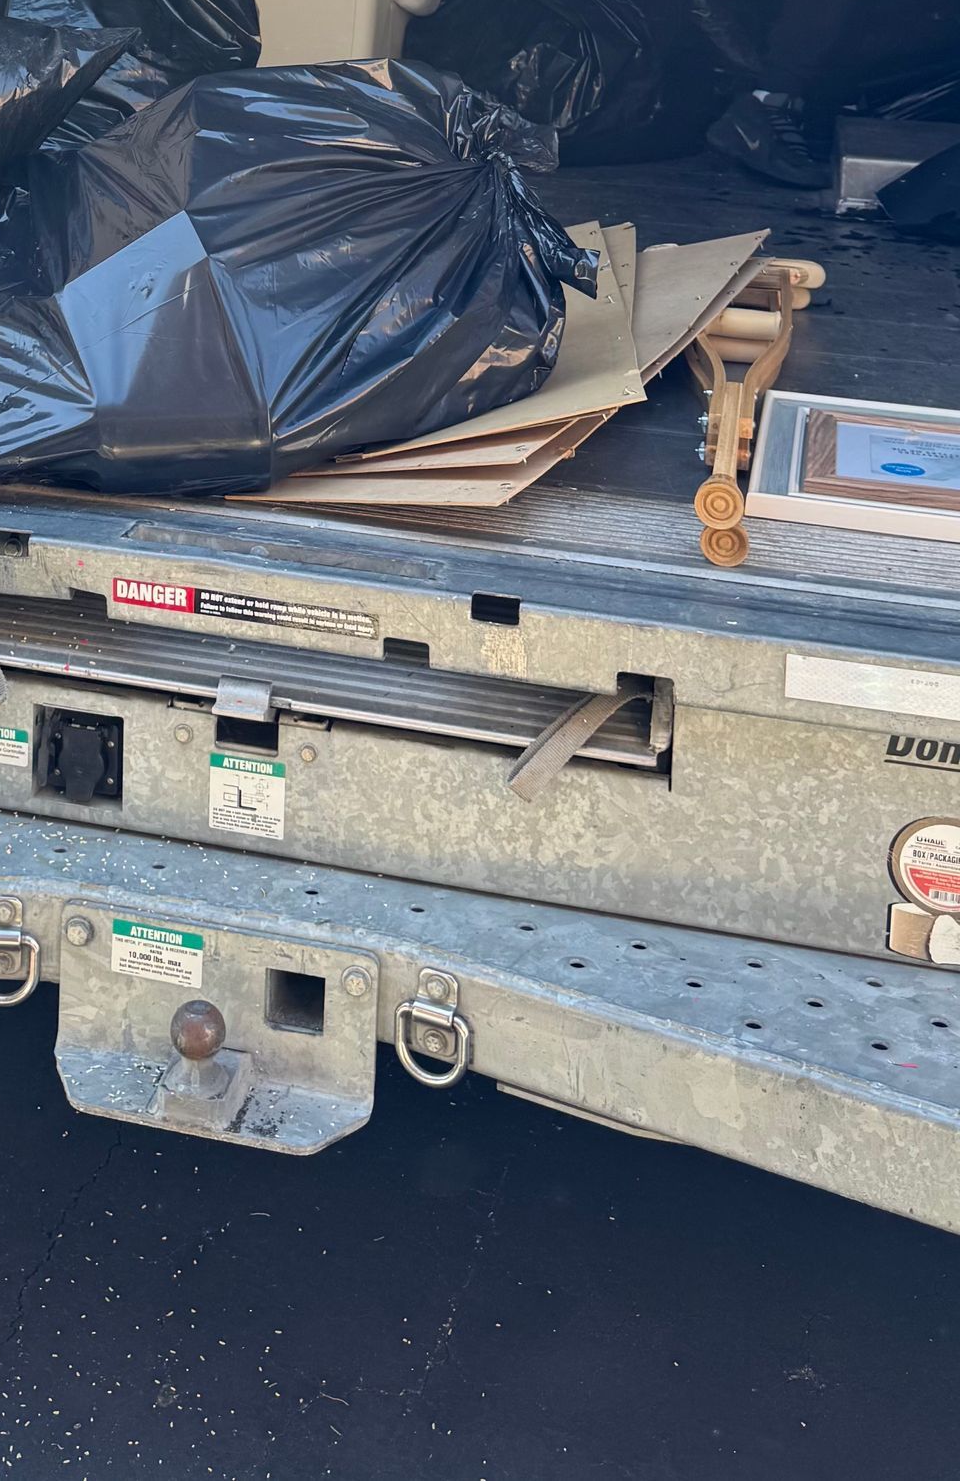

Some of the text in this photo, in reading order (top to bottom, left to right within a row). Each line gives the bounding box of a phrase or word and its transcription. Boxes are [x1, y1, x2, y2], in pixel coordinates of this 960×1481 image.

[116, 580, 187, 607] DANGER
[211, 593, 223, 602] NOT
[224, 597, 246, 606] extend
[222, 757, 273, 775] ATTENTION
[130, 925, 183, 945] ATTENTION
[129, 951, 182, 967] 10,000 lbs. max
